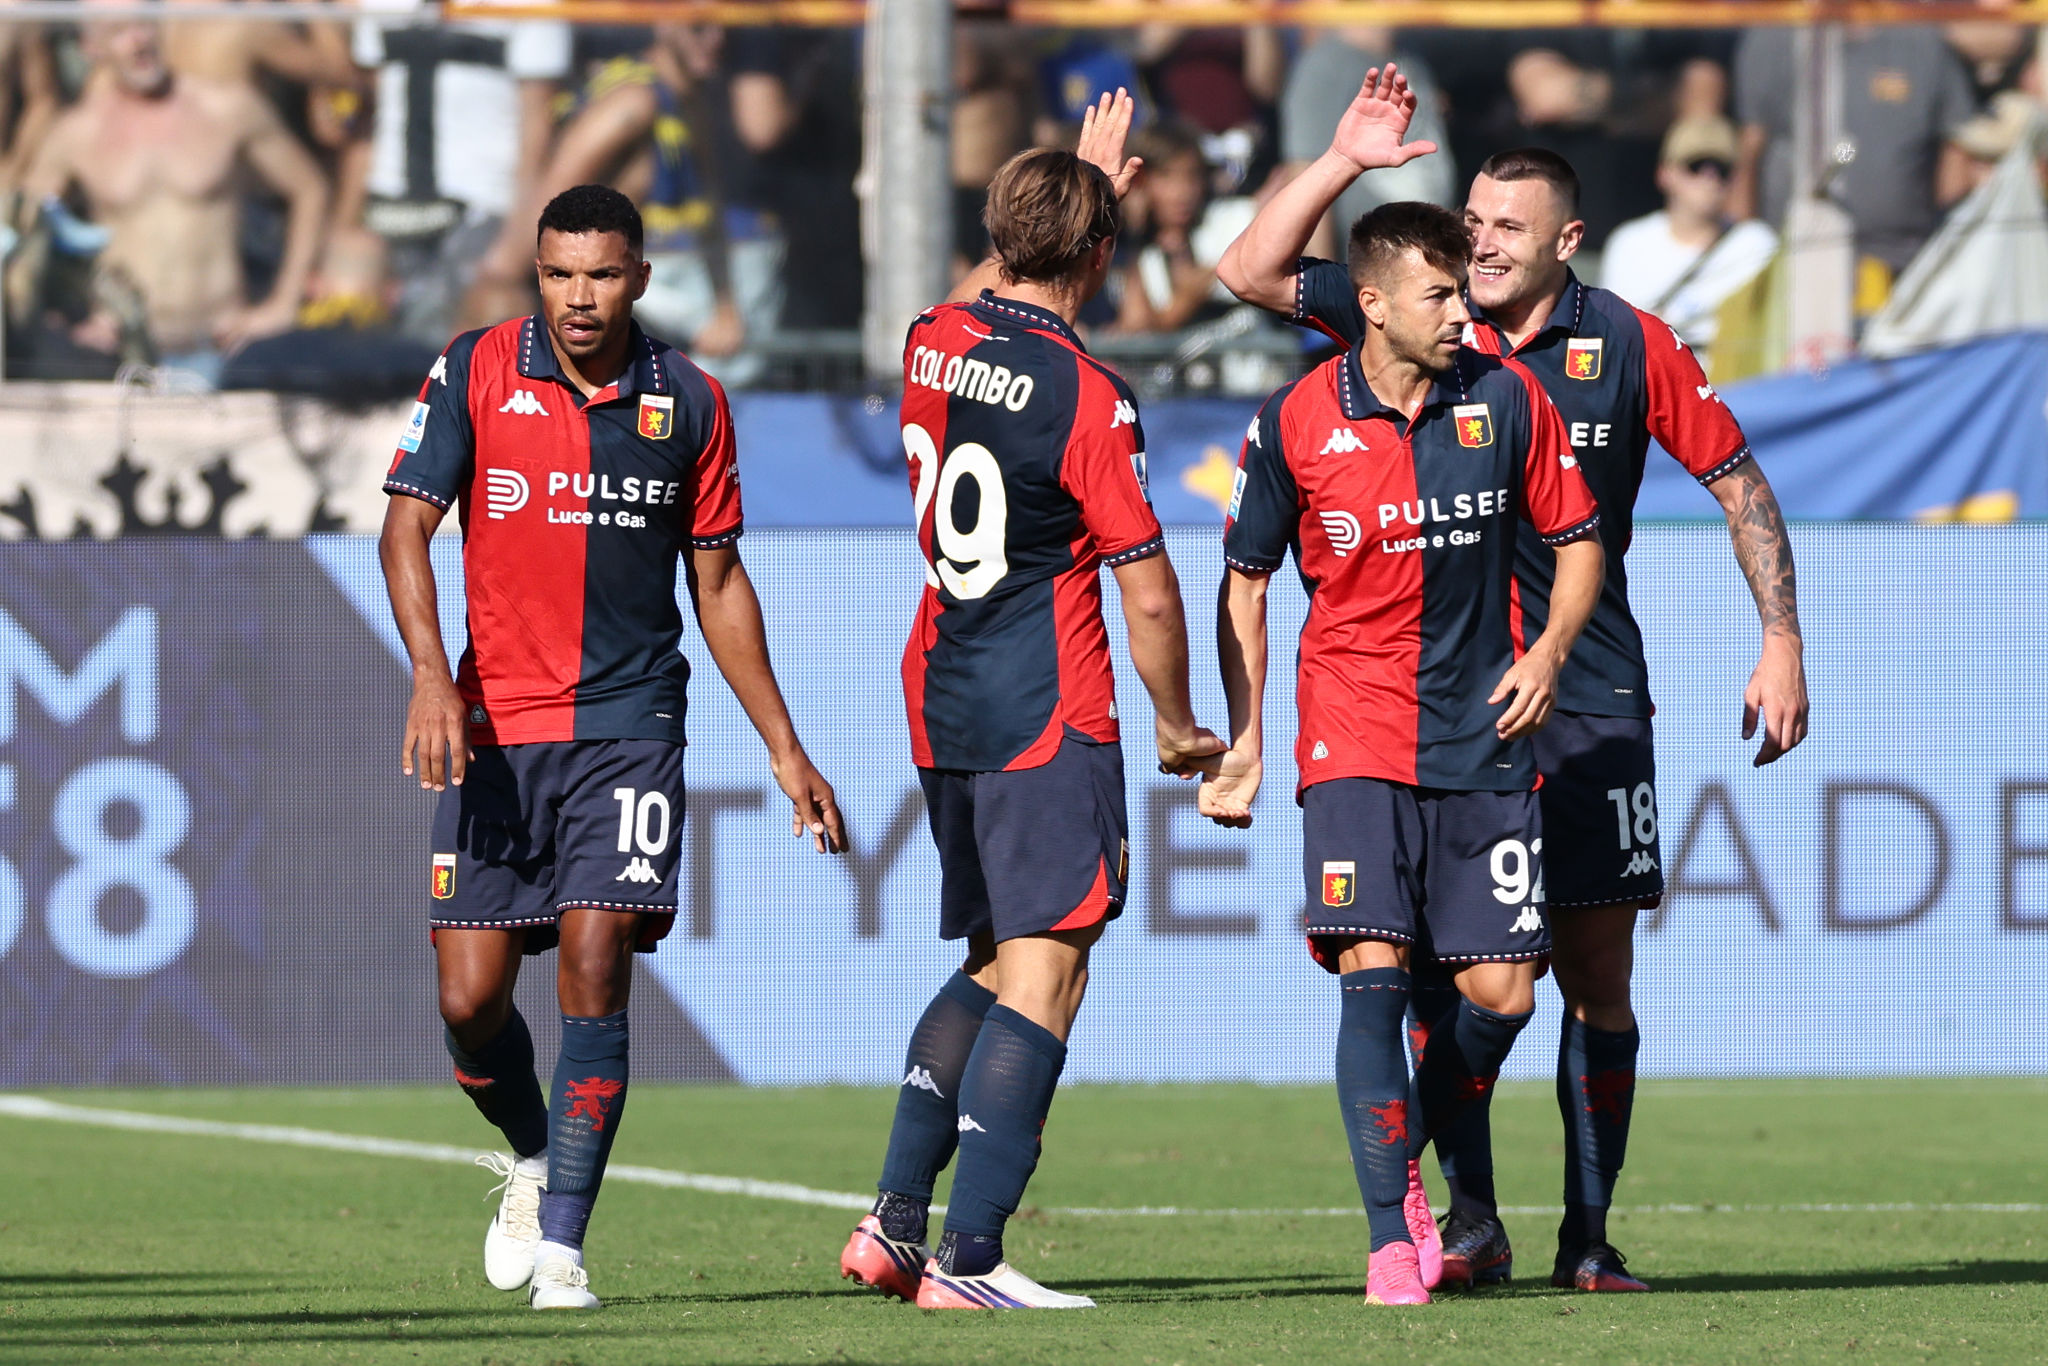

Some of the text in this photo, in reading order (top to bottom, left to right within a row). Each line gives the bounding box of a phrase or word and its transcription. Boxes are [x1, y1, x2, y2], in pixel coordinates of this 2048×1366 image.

[910, 345, 1034, 412] COLOMBO
[547, 508, 646, 528] Luce e Gas
[548, 471, 680, 505] PULSEE
[902, 423, 1009, 600] 29
[1378, 488, 1508, 529] PULSEE
[1382, 530, 1481, 554] Luce e Gas
[613, 787, 670, 856] 10
[1607, 781, 1657, 850] 18
[0, 756, 201, 979] 8
